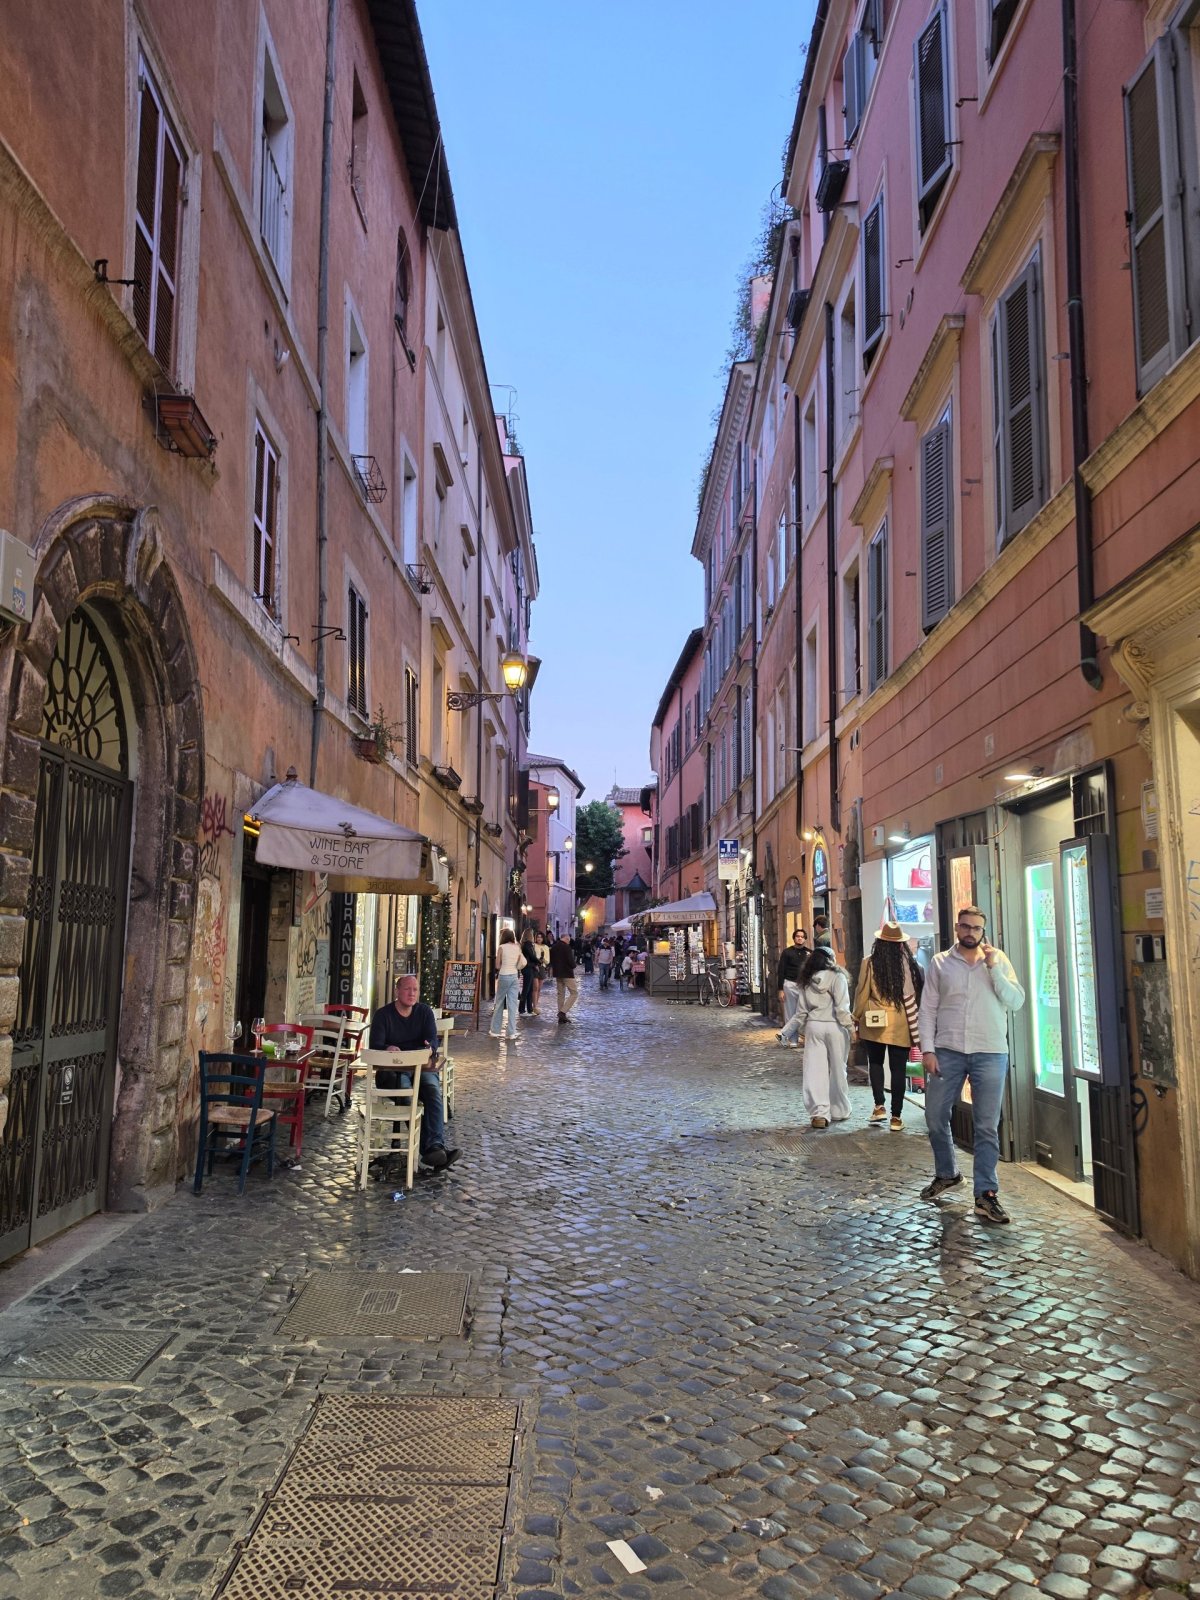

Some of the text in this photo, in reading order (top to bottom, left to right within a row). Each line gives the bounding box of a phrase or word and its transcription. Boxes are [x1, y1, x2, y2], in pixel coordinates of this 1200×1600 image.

[310, 838, 370, 855] WINE BAR
[310, 854, 365, 870] & STORE
